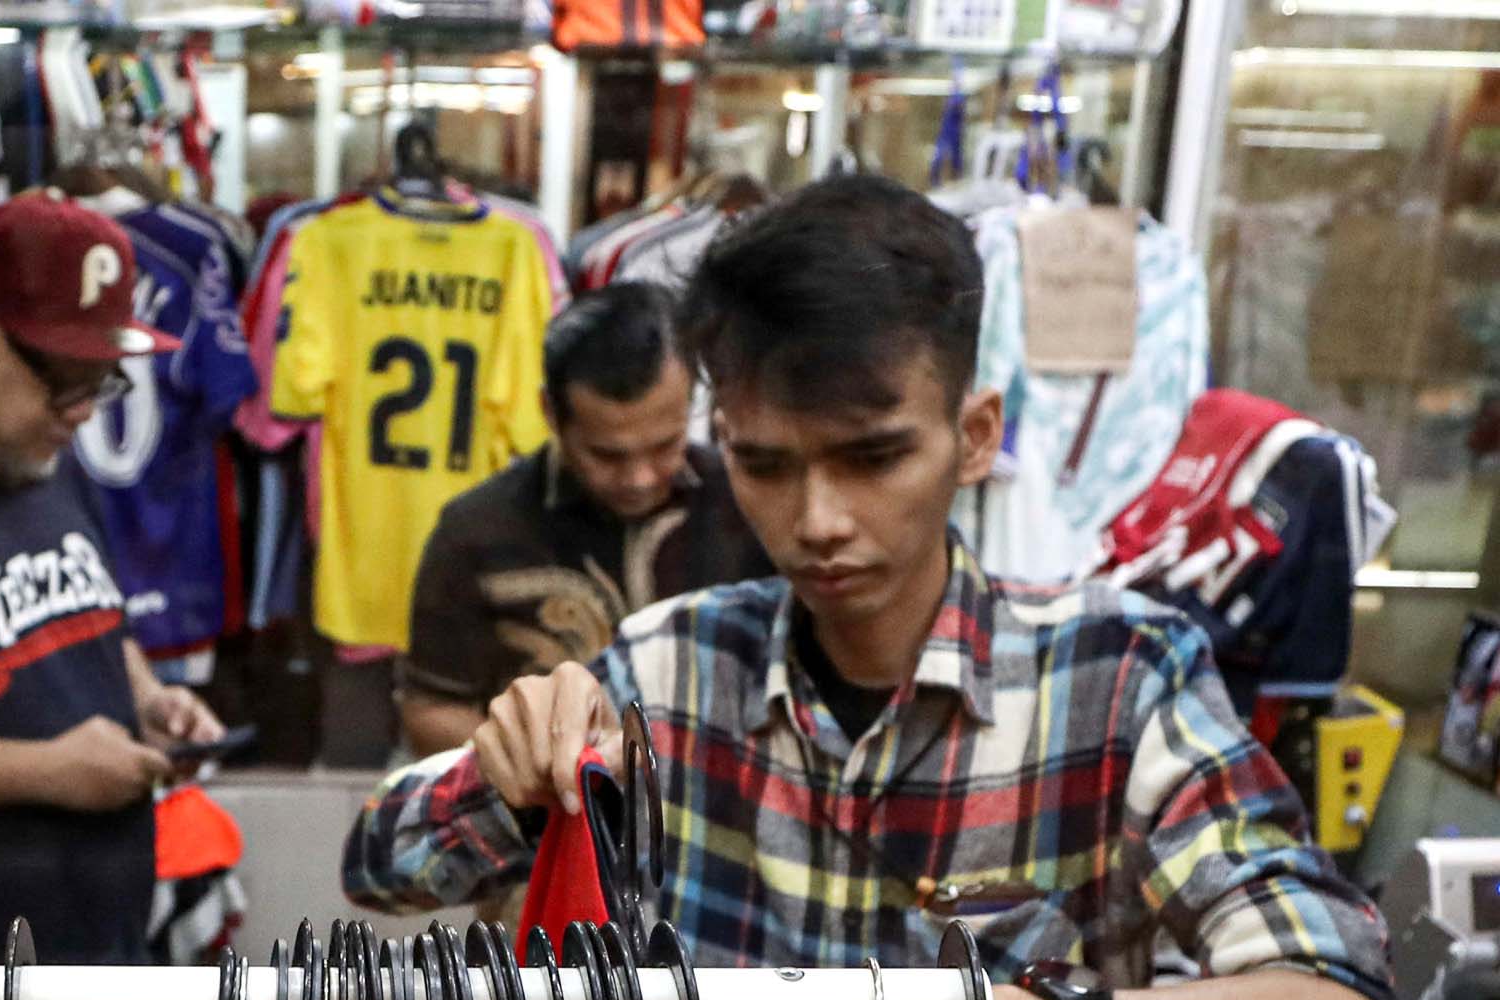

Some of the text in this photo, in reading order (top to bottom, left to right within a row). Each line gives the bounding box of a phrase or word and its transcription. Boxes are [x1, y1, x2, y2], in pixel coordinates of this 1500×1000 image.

[78, 243, 122, 310] P
[361, 268, 504, 316] JUANITO
[367, 333, 479, 473] 21
